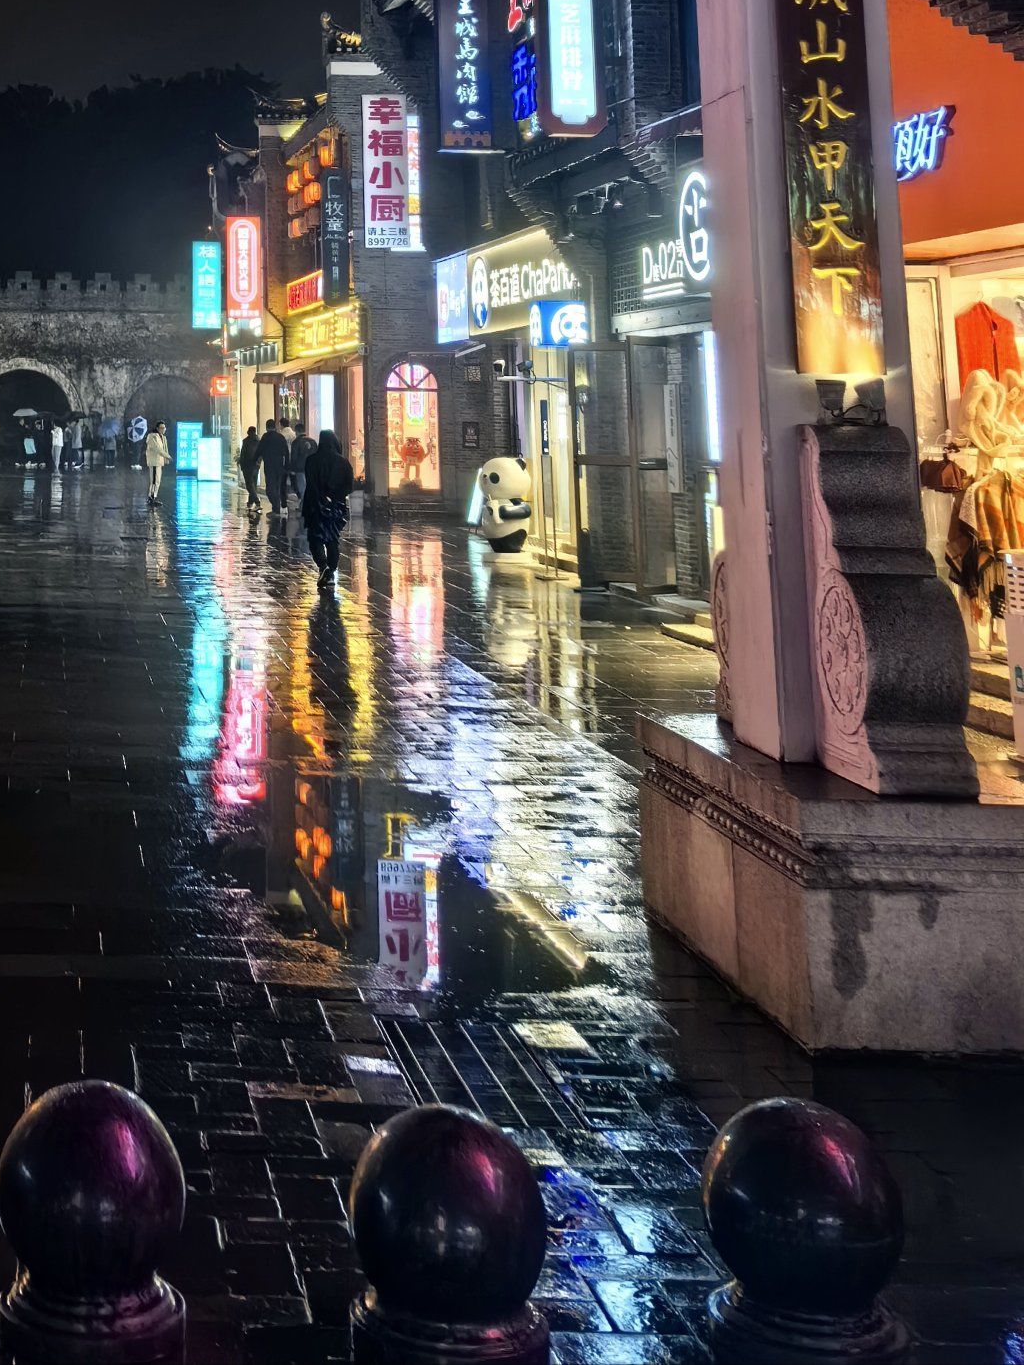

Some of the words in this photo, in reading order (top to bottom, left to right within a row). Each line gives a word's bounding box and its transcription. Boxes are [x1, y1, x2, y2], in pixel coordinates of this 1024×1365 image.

[367, 97, 405, 222] 幸福小厨
[326, 201, 345, 232] 牧童
[367, 237, 409, 247] 8997726
[489, 263, 521, 308] 茶百道
